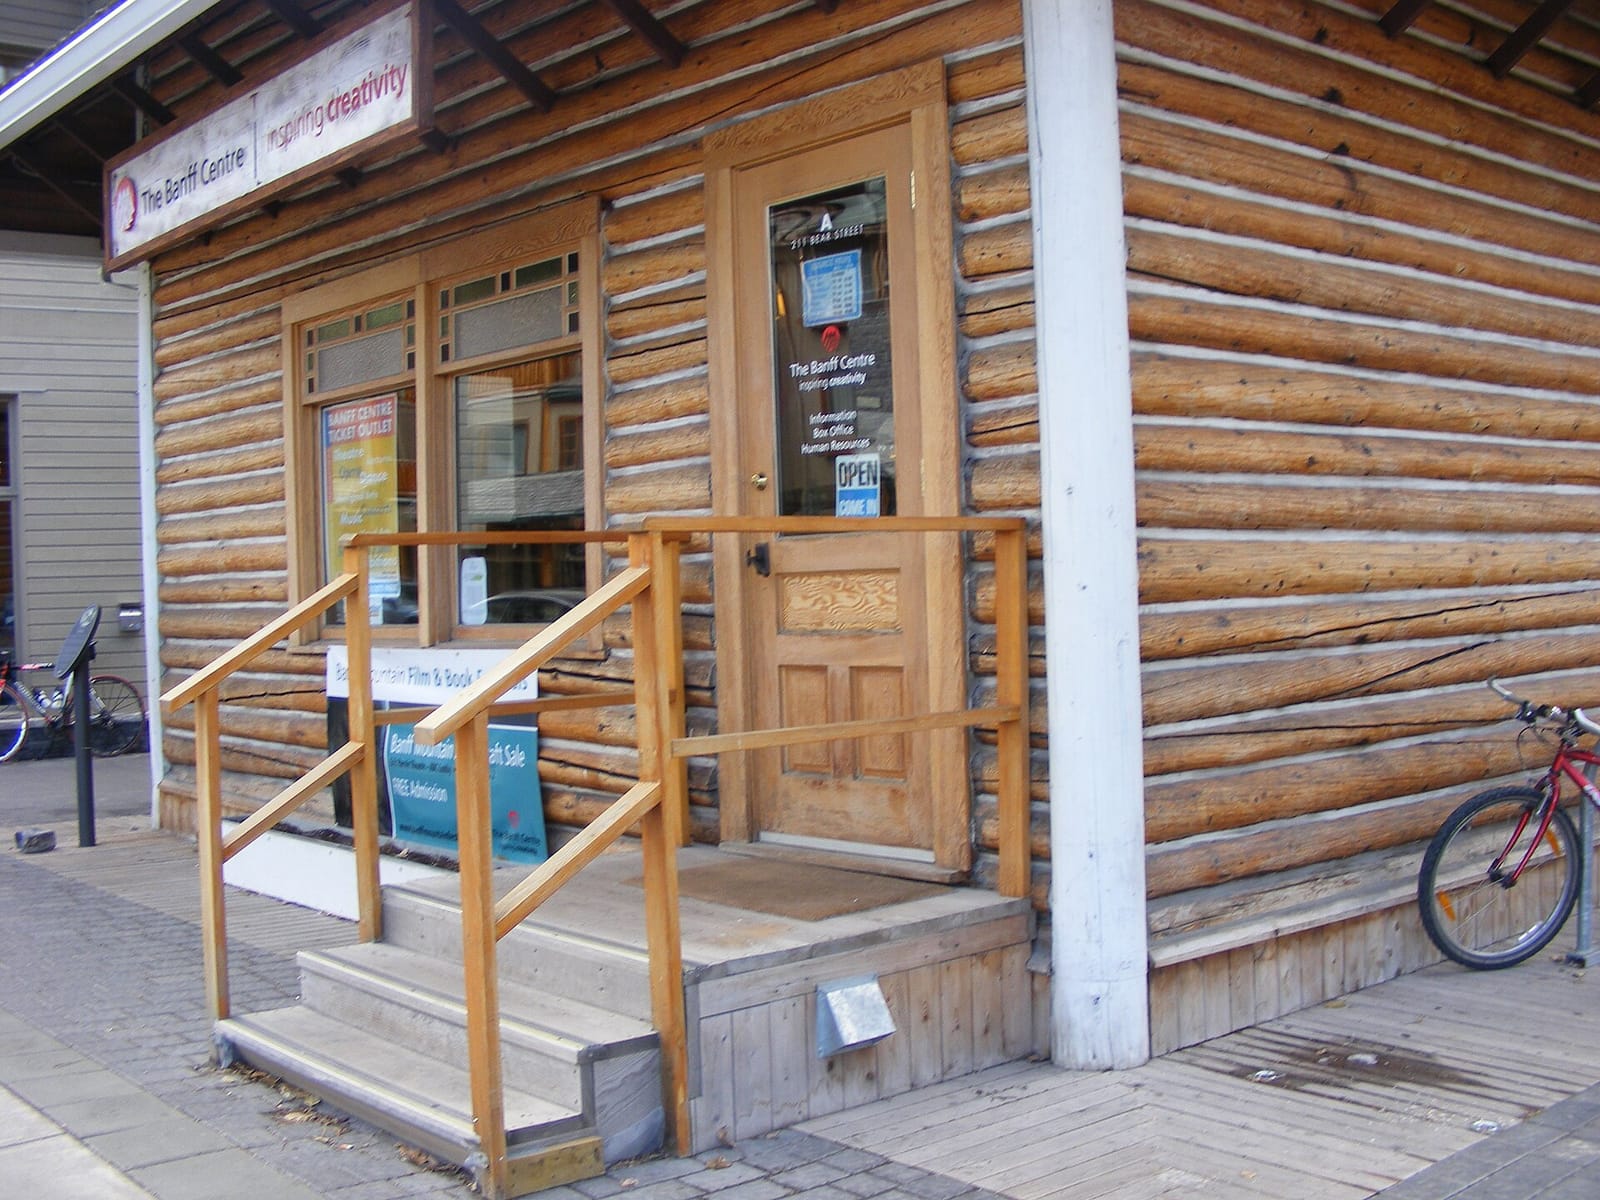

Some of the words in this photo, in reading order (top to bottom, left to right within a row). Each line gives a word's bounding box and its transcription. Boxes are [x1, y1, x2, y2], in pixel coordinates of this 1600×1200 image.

[266, 105, 323, 152] inspiring
[326, 63, 408, 122] creativity
[141, 187, 162, 215] The
[165, 162, 197, 205] Banff
[200, 147, 244, 187] Centre
[820, 212, 833, 232] A
[790, 237, 807, 250] 211
[809, 231, 832, 246] BEAR
[834, 223, 864, 240] STREET
[789, 362, 809, 377] The
[811, 355, 838, 375] Banff
[840, 353, 876, 370] Centre
[799, 377, 828, 393] inspiring
[829, 371, 867, 386] creativity
[328, 408, 356, 427] BANFF
[358, 401, 393, 421] CENTRE
[809, 409, 857, 425] Information
[328, 425, 356, 444] TICKET
[358, 418, 393, 438] OUTLET
[813, 427, 829, 440] Box
[829, 424, 854, 437] Office
[801, 442, 830, 455] Human
[830, 437, 870, 452] Resources
[838, 460, 878, 487] OPEN
[839, 499, 867, 517] COME
[867, 499, 878, 516] IN
[407, 665, 430, 687] Film
[433, 667, 442, 687] &
[445, 667, 472, 689] Book
[390, 733, 414, 755] Banff
[505, 744, 525, 768] Sale
[410, 780, 448, 803] Admission
